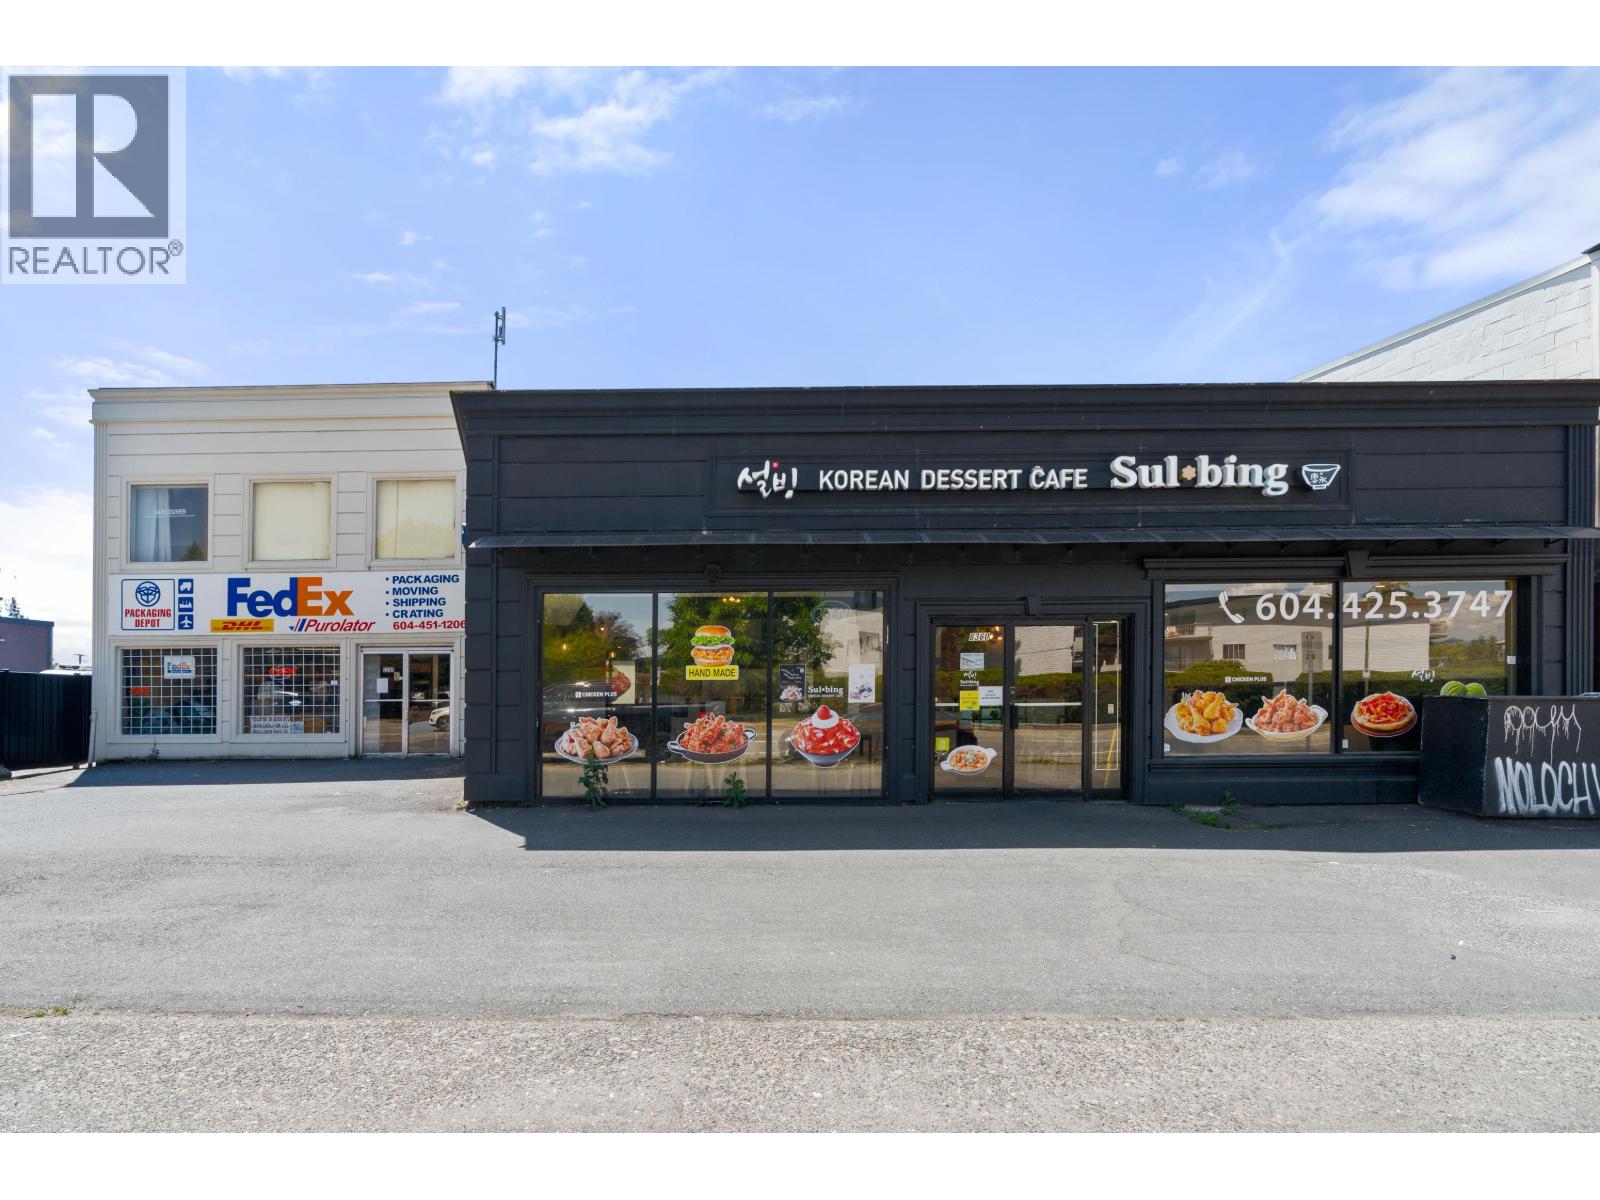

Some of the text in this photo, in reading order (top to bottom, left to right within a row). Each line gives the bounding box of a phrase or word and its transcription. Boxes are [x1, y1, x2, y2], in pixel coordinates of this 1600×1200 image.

[819, 468, 910, 491] KOREAN
[920, 468, 1023, 491] DESSERT
[392, 574, 460, 585] PACKAGING
[392, 586, 439, 596] MOVING
[227, 576, 354, 618] FedEx
[392, 597, 447, 608] SHIPPING
[1256, 589, 1513, 621] 604.425.3747
[124, 608, 172, 618] PACKAGING
[392, 608, 444, 619] CRATING
[134, 618, 161, 628] DEPOT
[222, 621, 263, 631] DHL
[304, 618, 376, 632] Purolator
[393, 620, 466, 630] 604-451-1206
[688, 668, 736, 678] HAND MADE
